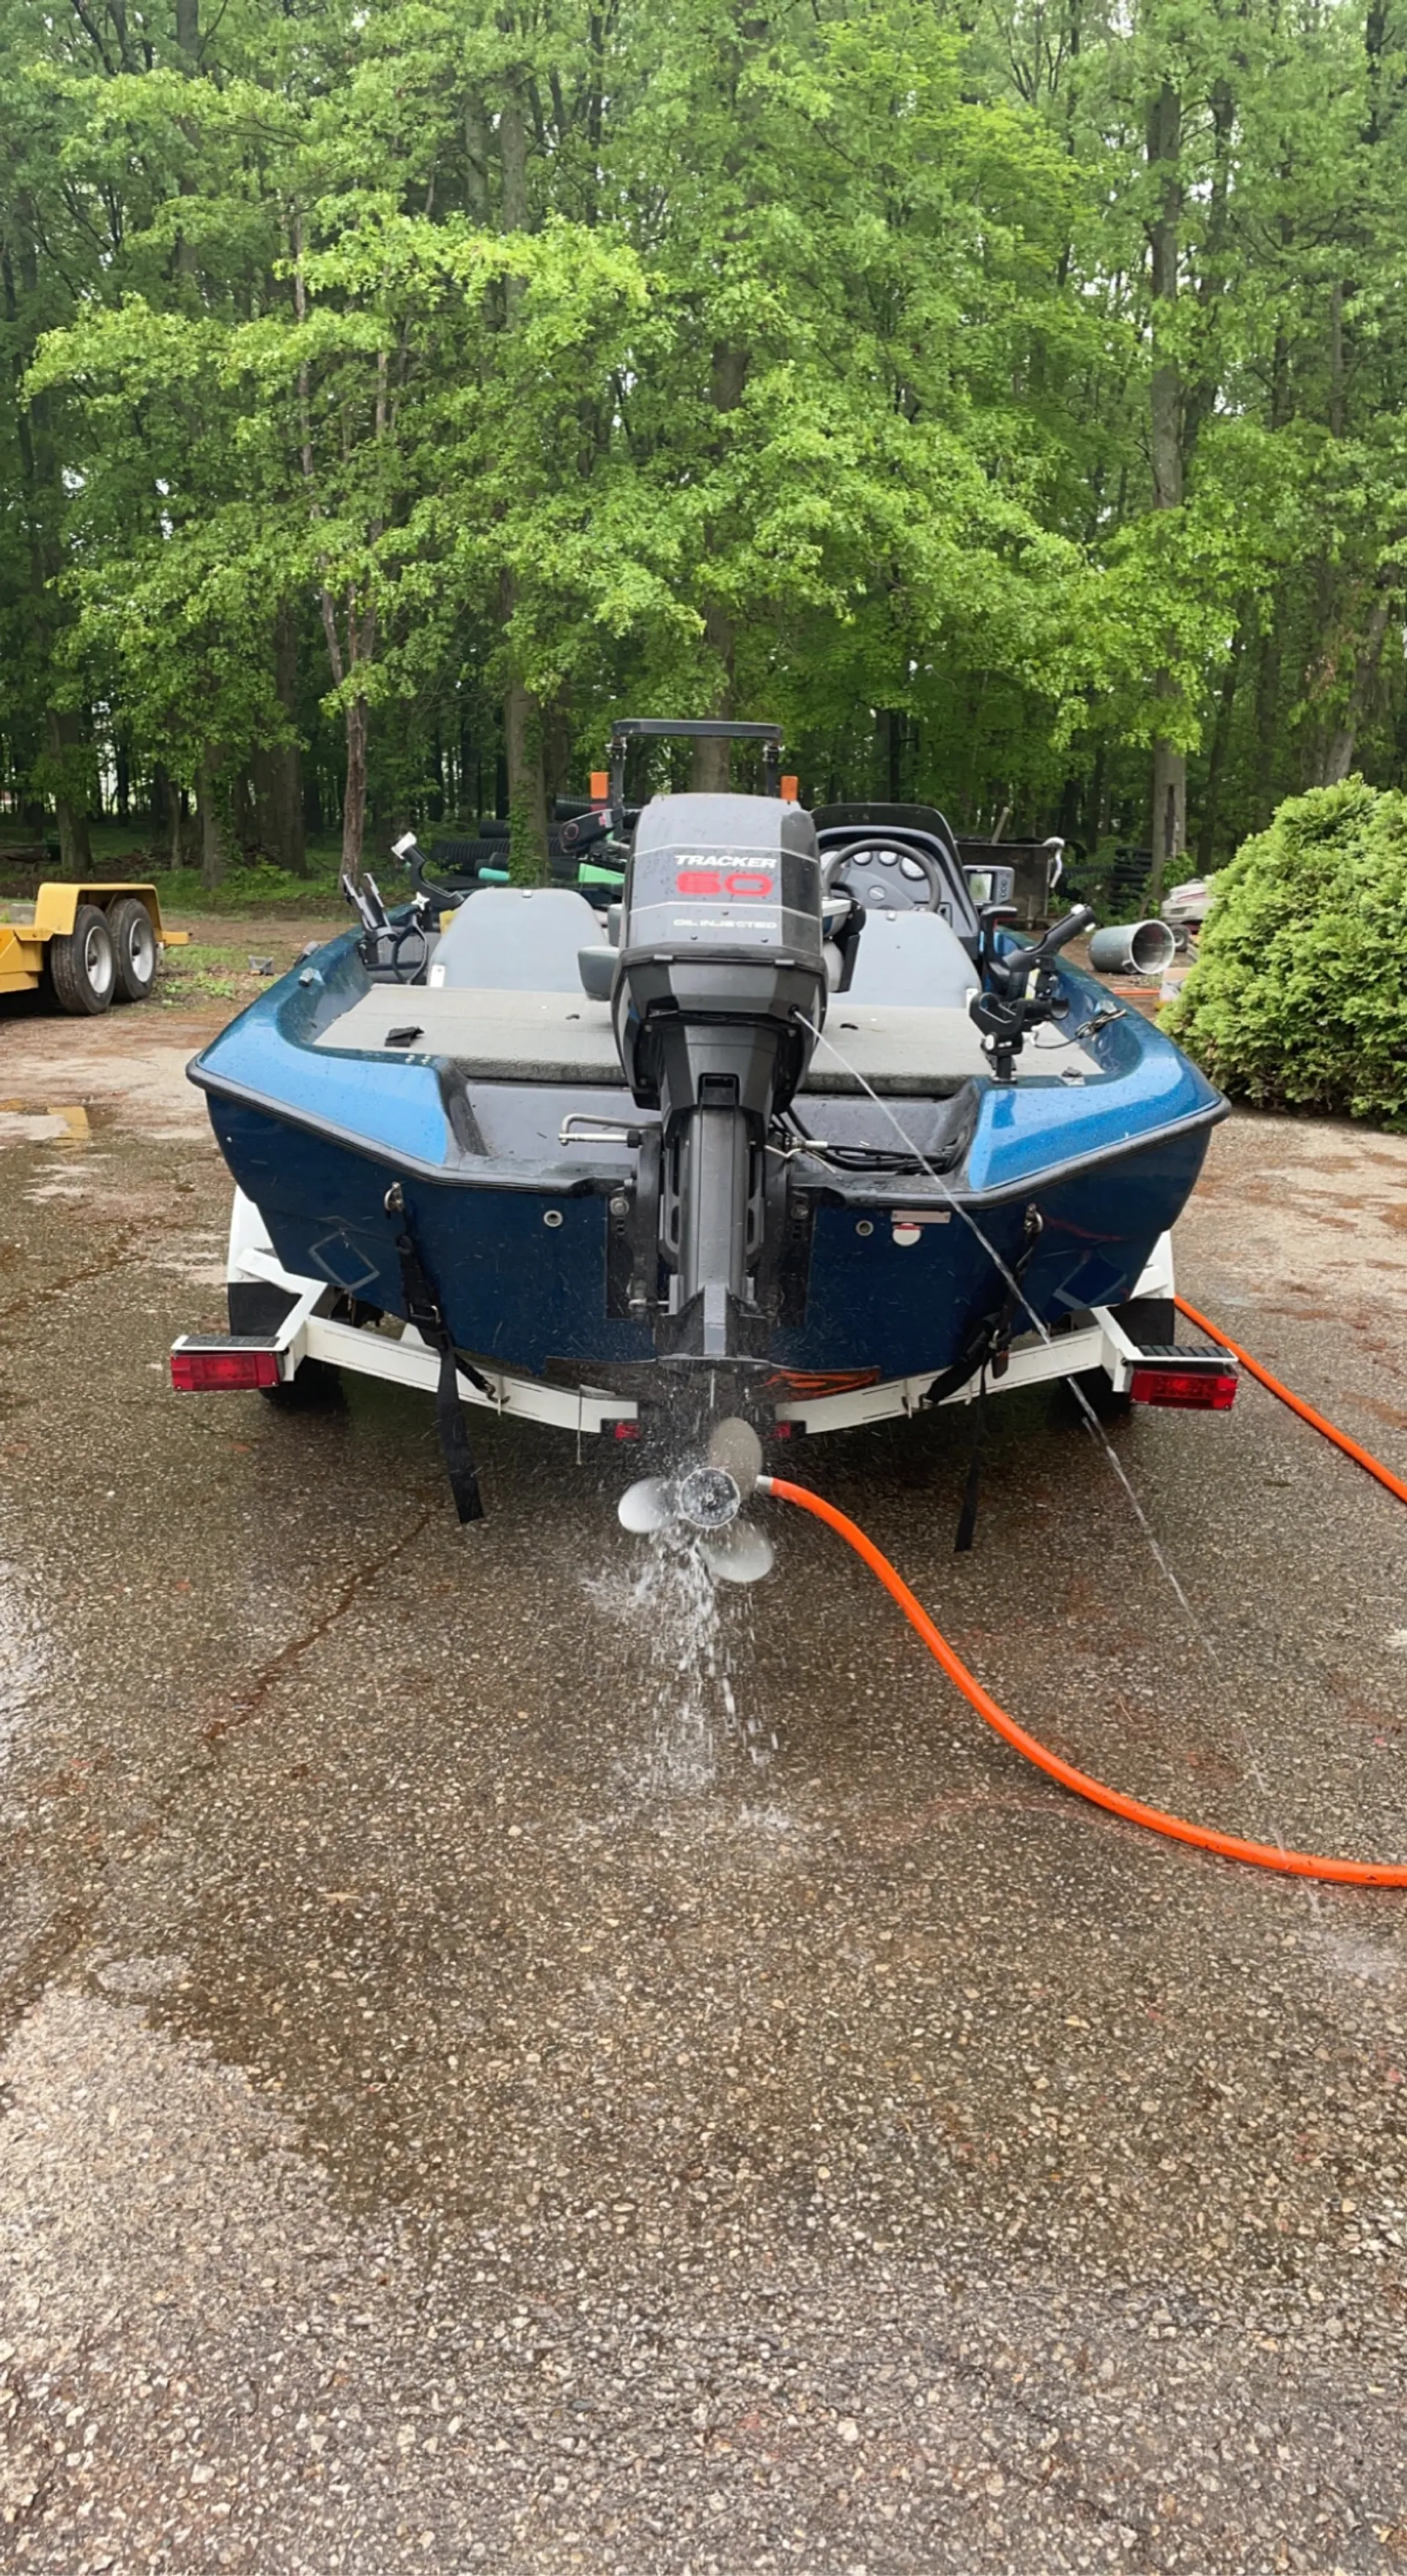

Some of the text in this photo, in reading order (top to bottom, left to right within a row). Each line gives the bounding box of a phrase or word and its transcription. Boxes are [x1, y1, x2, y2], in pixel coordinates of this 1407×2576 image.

[674, 855, 777, 868] TRACKER
[676, 871, 773, 896] 60
[700, 919, 778, 929] INJECTED
